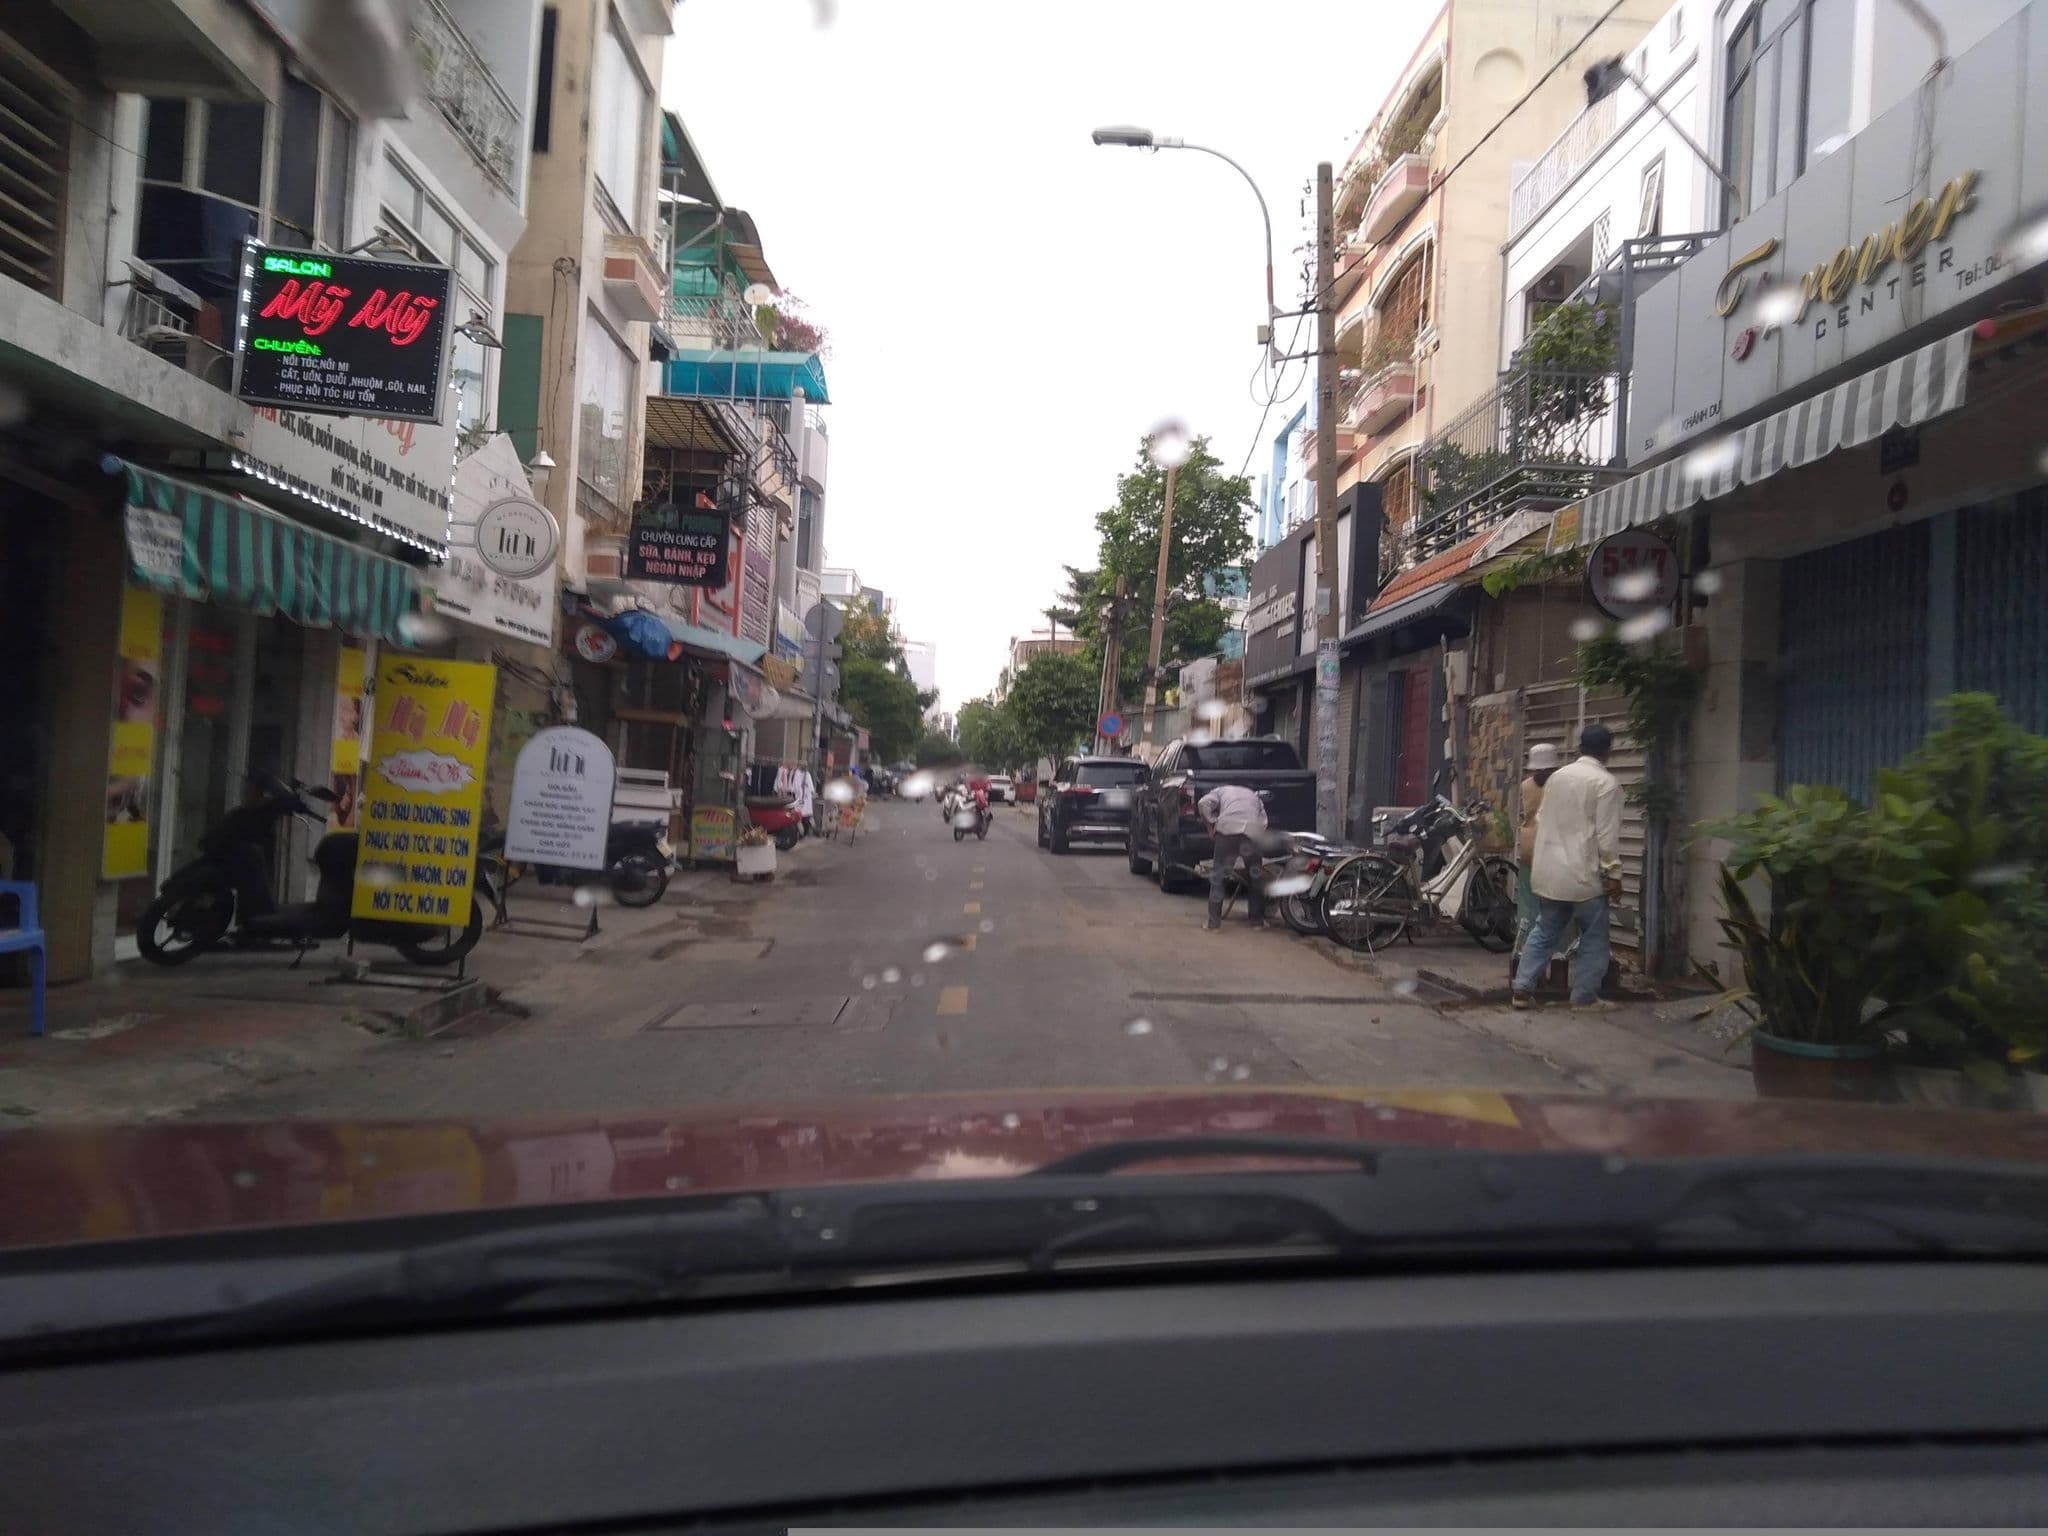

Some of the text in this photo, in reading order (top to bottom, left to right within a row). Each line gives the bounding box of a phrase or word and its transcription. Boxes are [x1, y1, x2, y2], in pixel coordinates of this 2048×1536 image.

[264, 256, 331, 278] SALON
[1955, 262, 1982, 290] Tel:
[1815, 247, 1954, 341] CENTER
[260, 278, 438, 346] Mỹ Mỹ
[337, 362, 349, 371] MI
[407, 383, 428, 395] NAIL
[641, 530, 675, 545] CHUYÊN
[676, 535, 699, 547] CUNG
